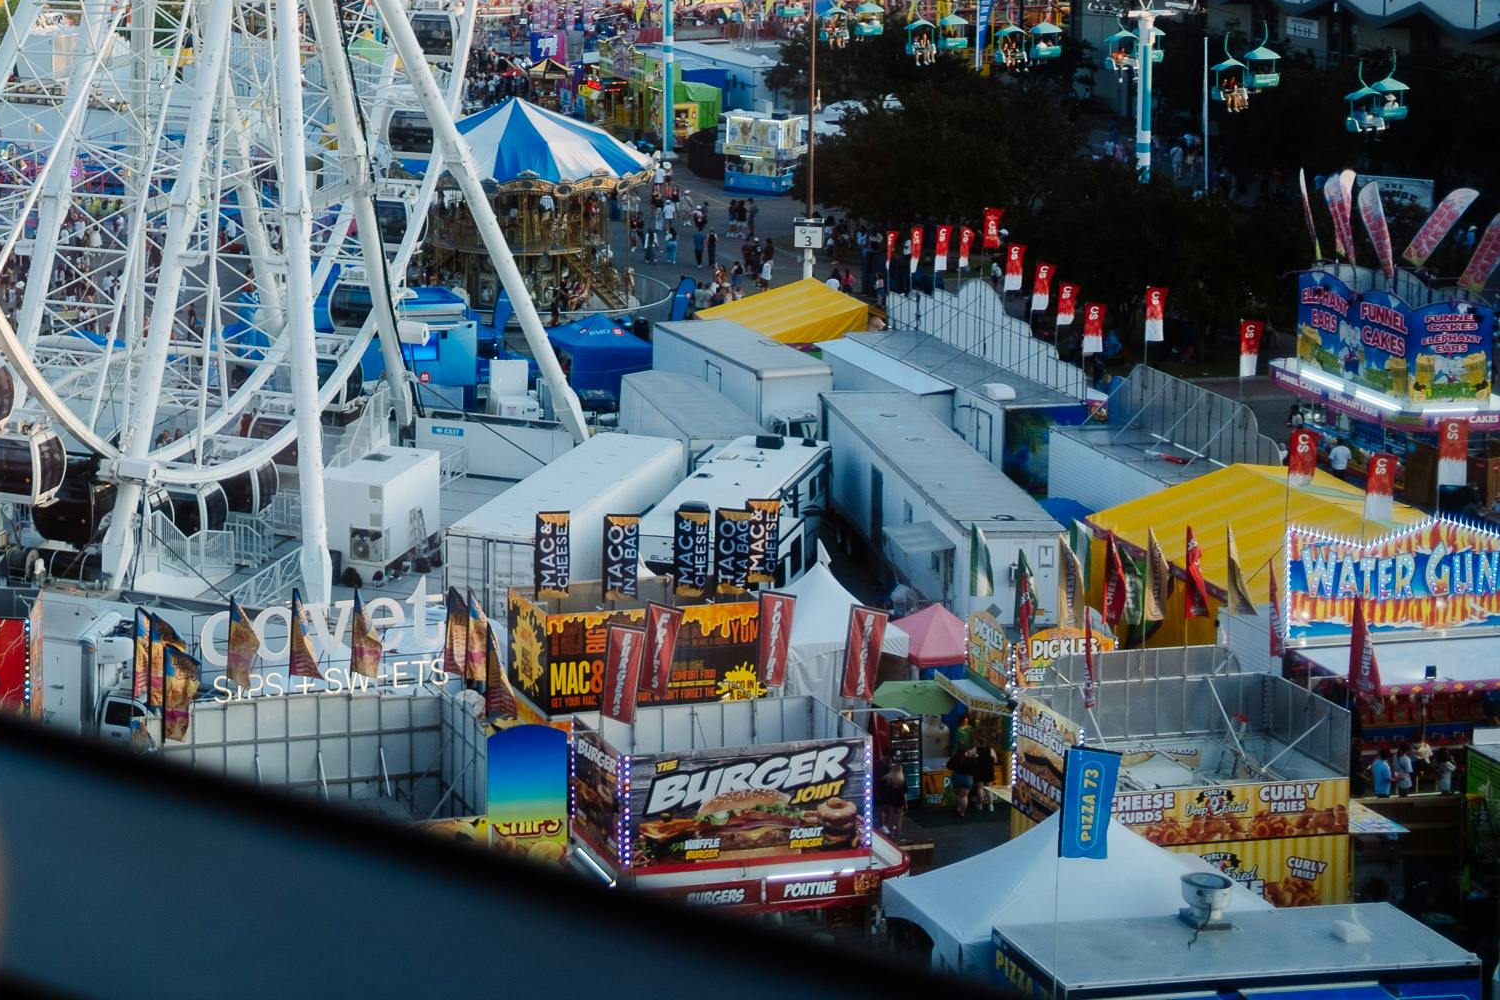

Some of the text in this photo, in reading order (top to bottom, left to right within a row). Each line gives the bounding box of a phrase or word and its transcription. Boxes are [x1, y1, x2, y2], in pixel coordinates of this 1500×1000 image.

[805, 235, 812, 246] 3
[1311, 308, 1338, 333] EARS
[1360, 301, 1408, 335] FUNNEL
[1424, 313, 1477, 323] FUNNE
[1427, 323, 1479, 331] CAKES
[1362, 325, 1405, 356] CAKES
[1421, 333, 1482, 345] ELEPHANT
[1435, 344, 1468, 353] EARS
[1300, 381, 1322, 395] CAKES
[1469, 415, 1499, 423] CAKES
[625, 524, 637, 558] BAG
[737, 520, 749, 554] BAG
[750, 510, 765, 571] MAC &
[765, 512, 778, 573] CHEESE
[540, 522, 556, 587] MAC &
[556, 525, 568, 588] CHEESE
[607, 525, 624, 590] TACO
[678, 520, 693, 584] MAC &
[695, 525, 707, 587] CHEESE
[719, 521, 735, 583] TACO
[736, 558, 748, 570] A
[624, 564, 636, 575] A
[1301, 546, 1415, 600] WATER
[975, 616, 1004, 651] PICKLES
[324, 658, 449, 694] SWETS
[550, 661, 590, 696] MAC
[577, 739, 617, 774] BURGER
[656, 760, 678, 773] THE
[646, 746, 849, 814] BURGER
[791, 780, 845, 804] JOINT
[1017, 765, 1049, 795] CURLY
[1111, 792, 1175, 812] CHEESE
[1259, 783, 1319, 802] CURLY
[1081, 769, 1099, 842] PIZZA 73
[1117, 810, 1164, 825] CURDS
[1185, 803, 1209, 817] Deep
[1270, 800, 1307, 813] FRIES
[789, 827, 824, 839] DONUT
[790, 837, 823, 849] BURGER
[1287, 856, 1327, 873] CURLY
[1291, 868, 1317, 880] FRIES
[687, 889, 745, 905] BURGERS
[784, 880, 837, 898] POUTINE
